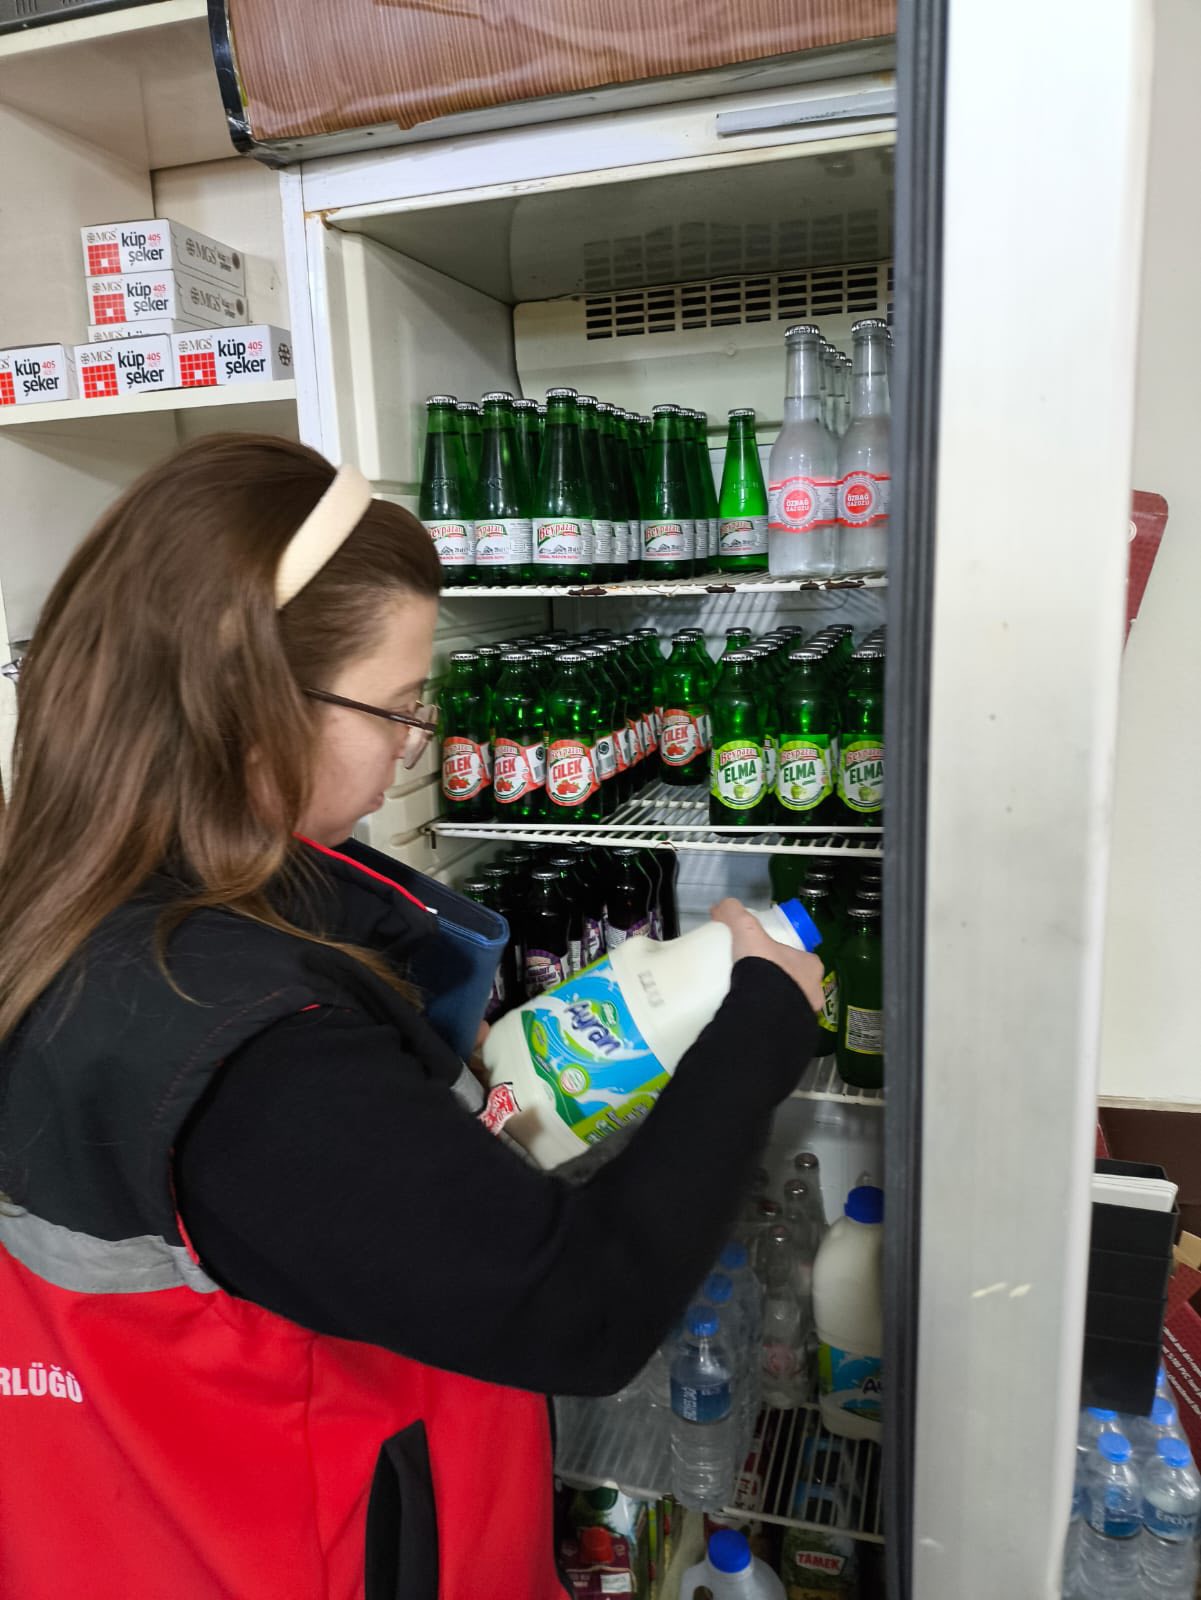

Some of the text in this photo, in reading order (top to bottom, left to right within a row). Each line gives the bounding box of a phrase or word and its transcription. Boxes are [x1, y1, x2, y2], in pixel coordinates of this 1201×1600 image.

[95, 230, 117, 242] MGS
[121, 231, 147, 247] küp
[129, 245, 164, 266] şeker
[100, 280, 123, 293] MGS
[126, 281, 152, 298] küp
[134, 296, 169, 314] şeker
[90, 348, 112, 361] MGS
[188, 338, 212, 352] MGS
[217, 339, 263, 359] küp 405
[14, 358, 41, 379] küp
[118, 350, 145, 368] küp
[225, 357, 266, 379] şeker
[126, 365, 164, 385] şeker
[23, 375, 60, 397] şeker
[724, 760, 757, 784] ELMA
[783, 761, 816, 784] ELMA
[849, 761, 884, 785] ELMA
[564, 1000, 621, 1055] Ayran
[0, 1362, 83, 1403] RLÜĞÜ
[1177, 1366, 1191, 1379] PVC
[798, 1552, 840, 1569] TAMEK
